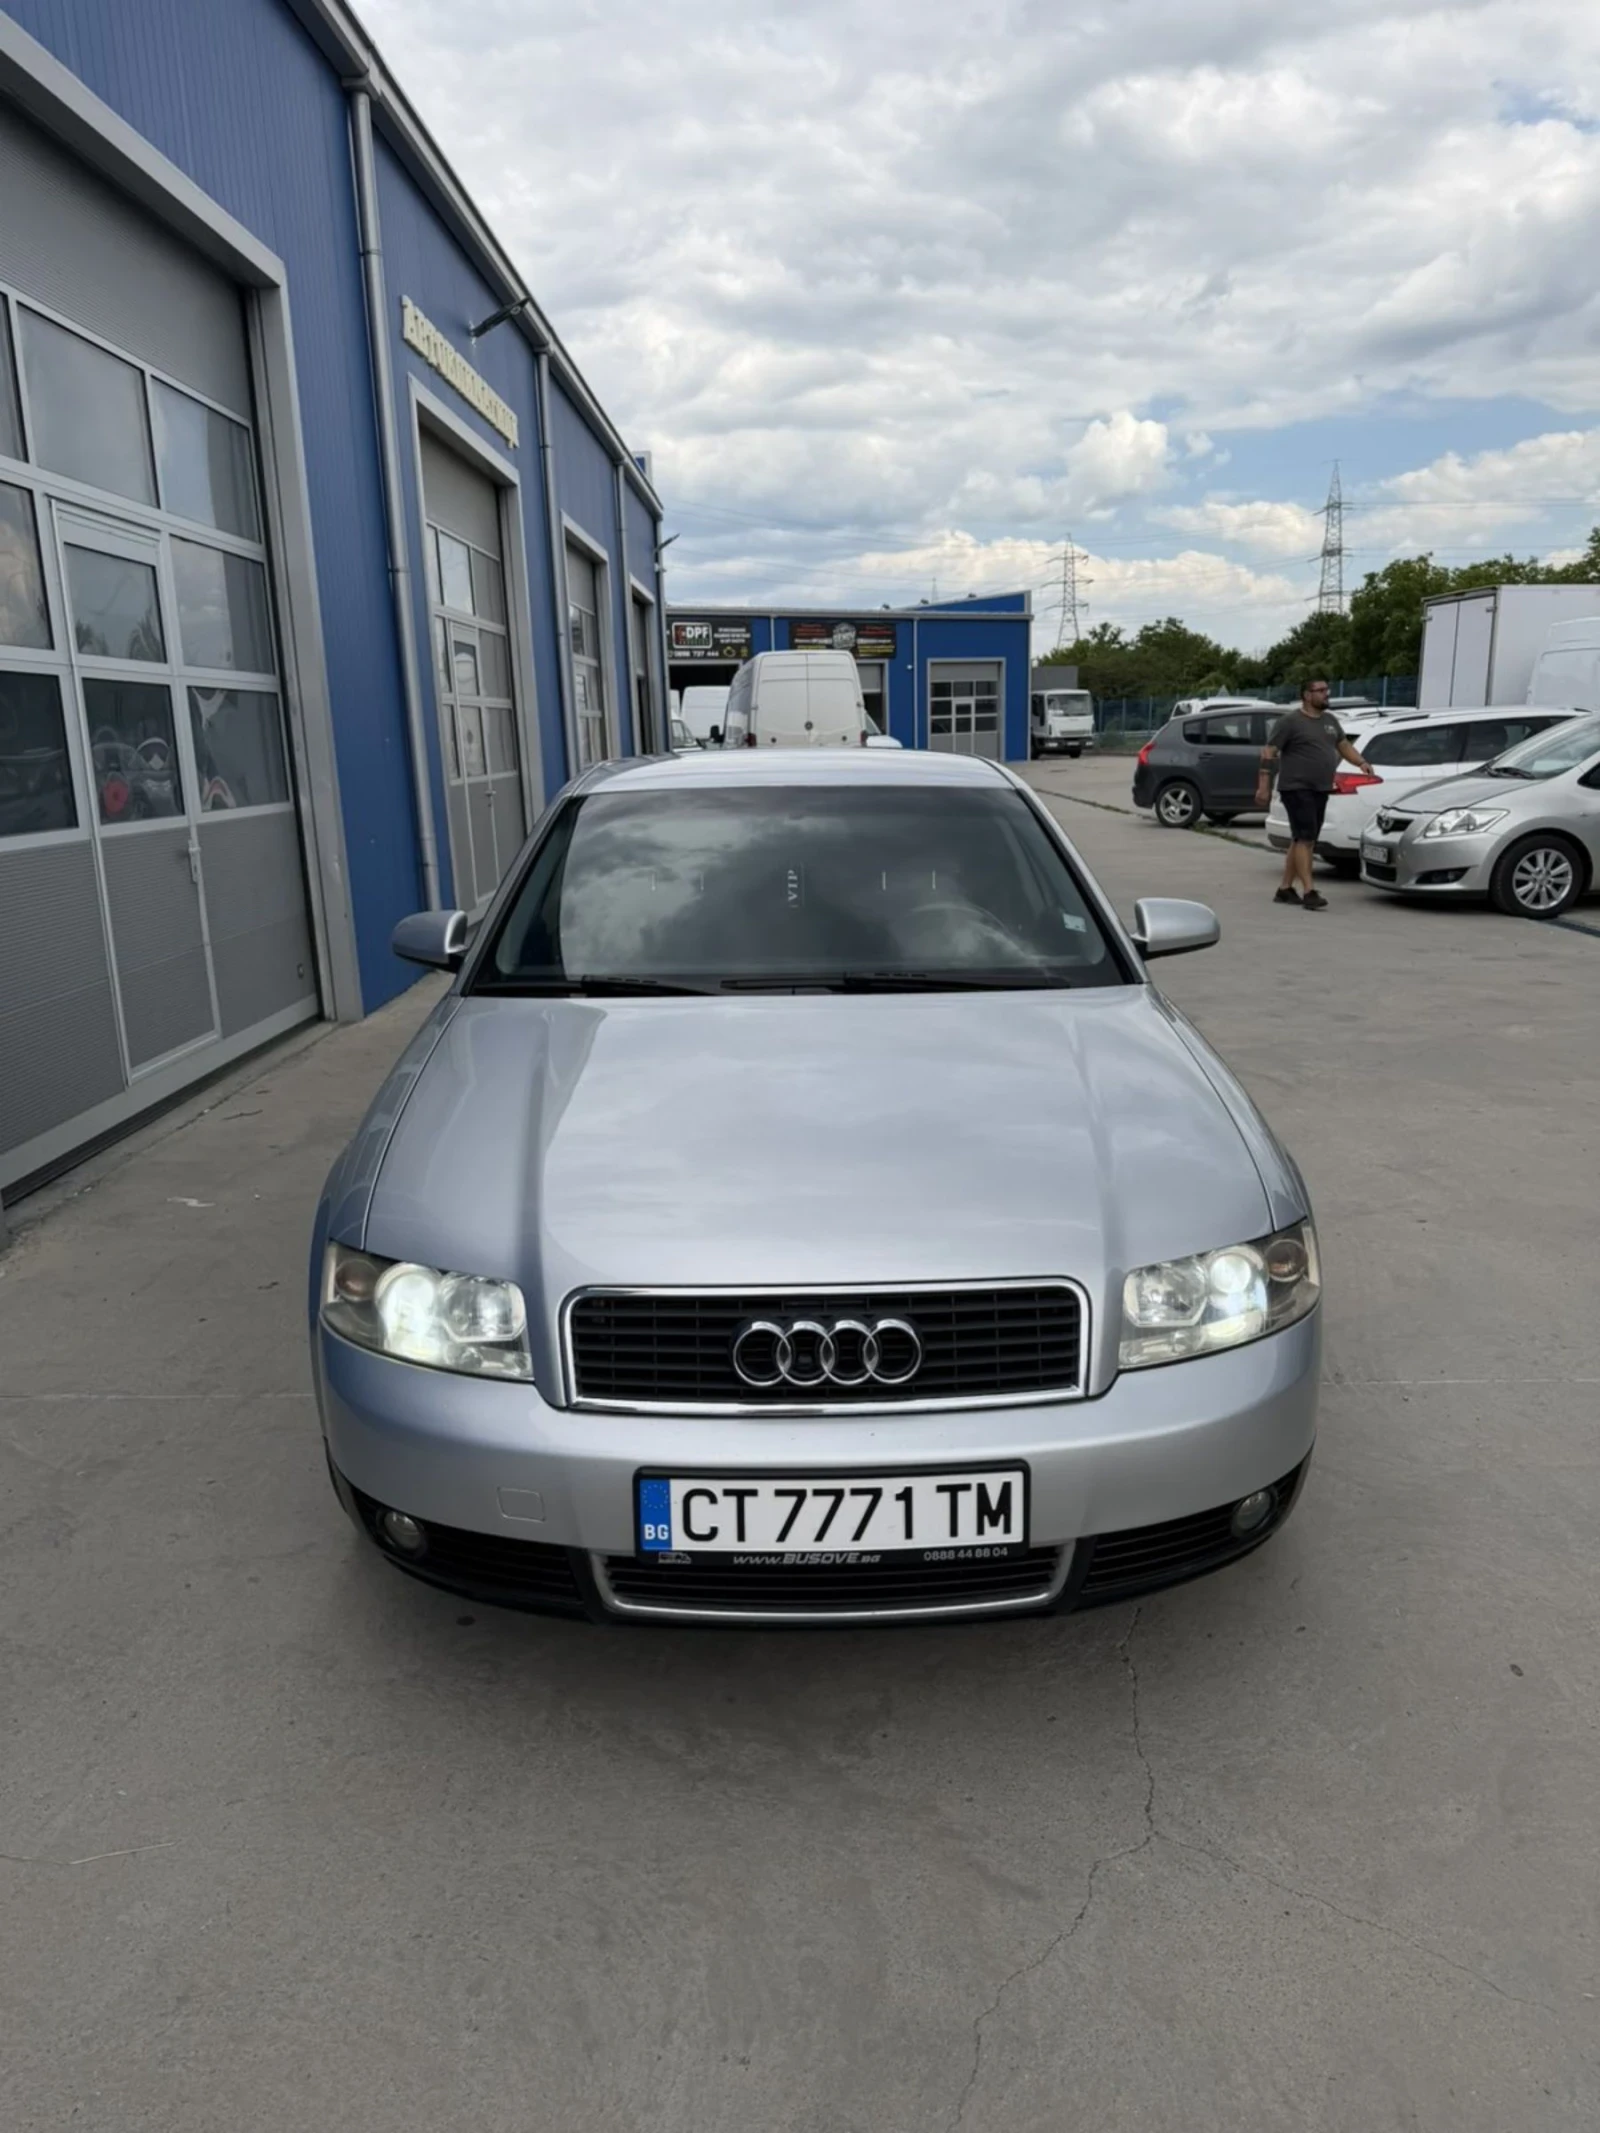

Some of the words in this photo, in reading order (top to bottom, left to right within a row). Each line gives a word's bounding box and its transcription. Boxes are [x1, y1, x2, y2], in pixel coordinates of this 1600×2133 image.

[686, 627, 709, 639] DPF
[682, 1488, 759, 1542] CT
[774, 1486, 914, 1542] 7771
[936, 1481, 1013, 1537] TM
[644, 1524, 669, 1540] BG
[923, 1550, 955, 1561] 0888
[957, 1549, 972, 1559] 44
[992, 1546, 1008, 1557] 04
